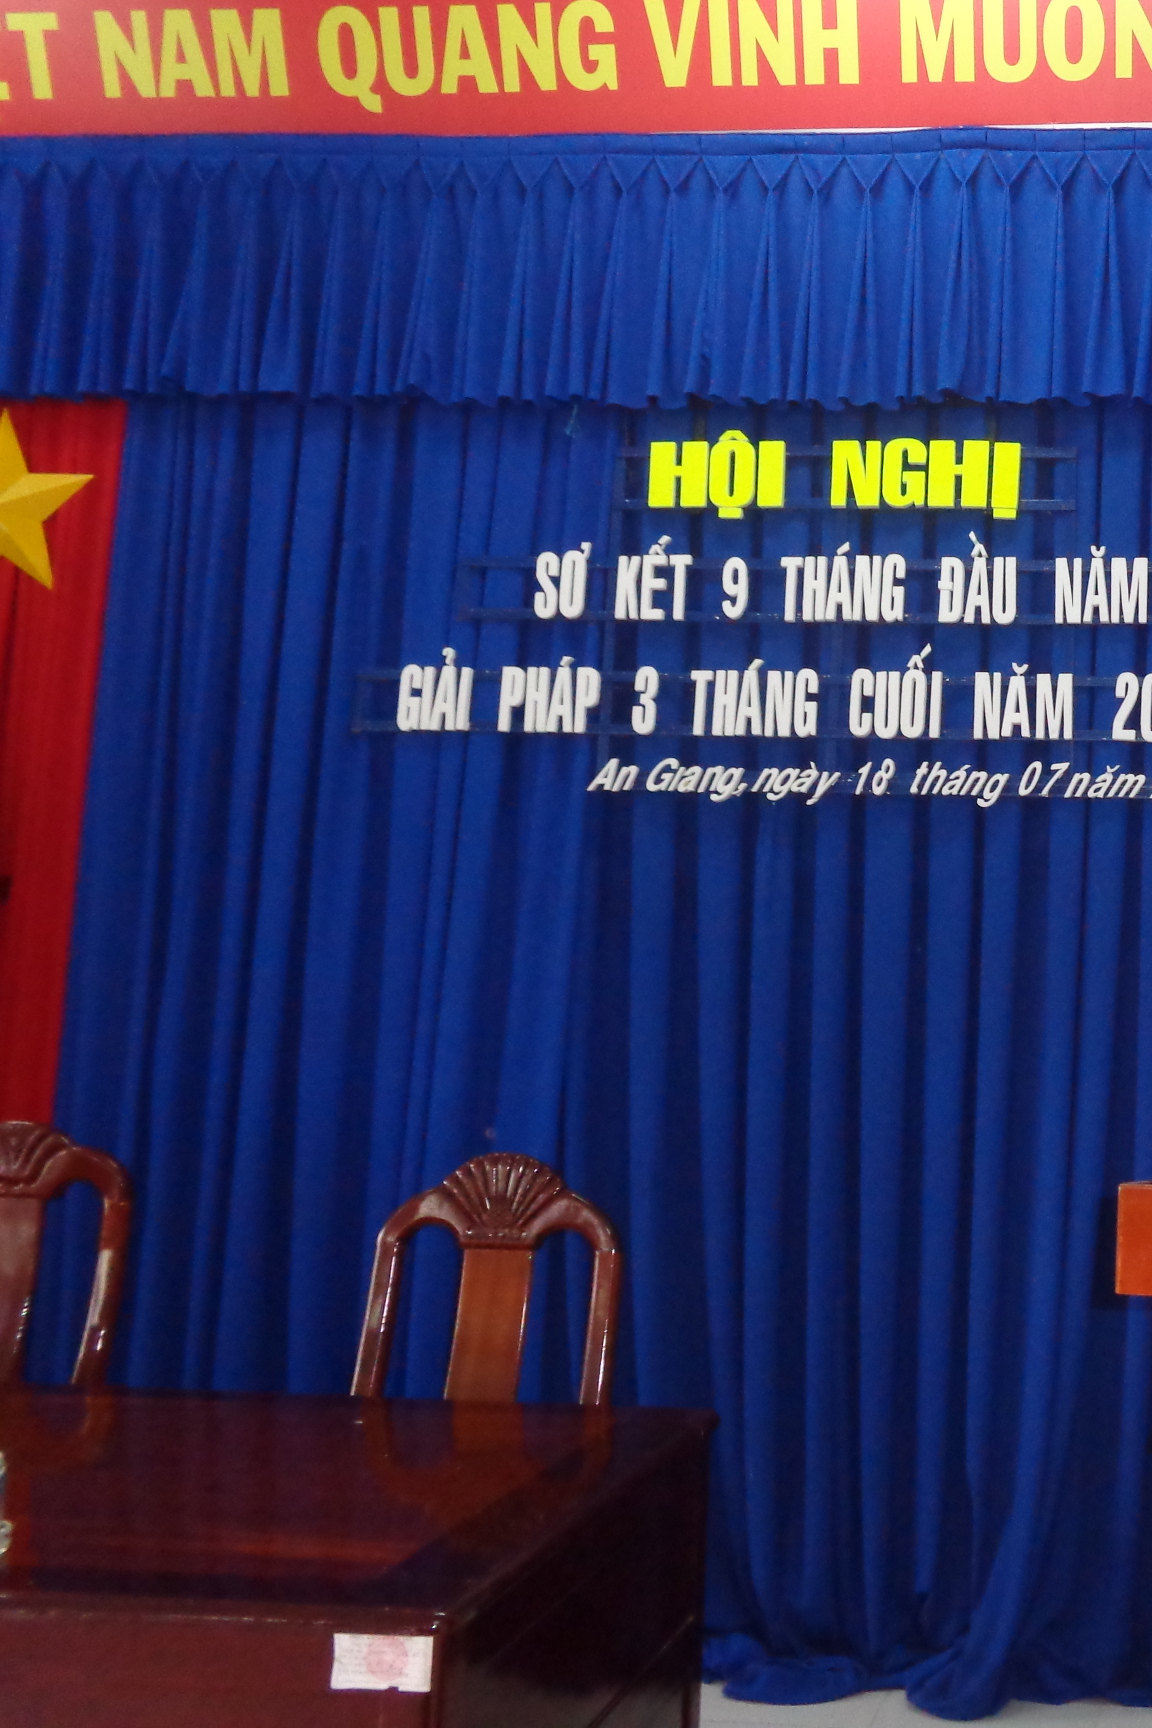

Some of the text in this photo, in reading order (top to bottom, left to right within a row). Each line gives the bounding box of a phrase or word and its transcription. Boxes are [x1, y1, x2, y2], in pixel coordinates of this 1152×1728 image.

[0, 12, 60, 99] T
[93, 8, 290, 99] NAM
[317, 0, 618, 113] QUANG
[643, 0, 859, 87] VINH
[648, 429, 1021, 520] HỘI NGHỊ
[533, 530, 1149, 624] SƠ KẾT 9 THÁNG ĐẦU NĂM
[396, 646, 474, 732] GIẢI
[497, 656, 601, 733] PHÁP
[631, 666, 660, 736] 3
[690, 658, 819, 738] THÁNG
[848, 643, 943, 739] CUỐI
[973, 662, 1073, 740] NĂM
[587, 757, 639, 792] An
[750, 760, 841, 805] ngày
[854, 758, 896, 796] 18
[909, 760, 1009, 808] tháng
[1017, 760, 1071, 797] 07
[1067, 764, 1148, 800] năm
